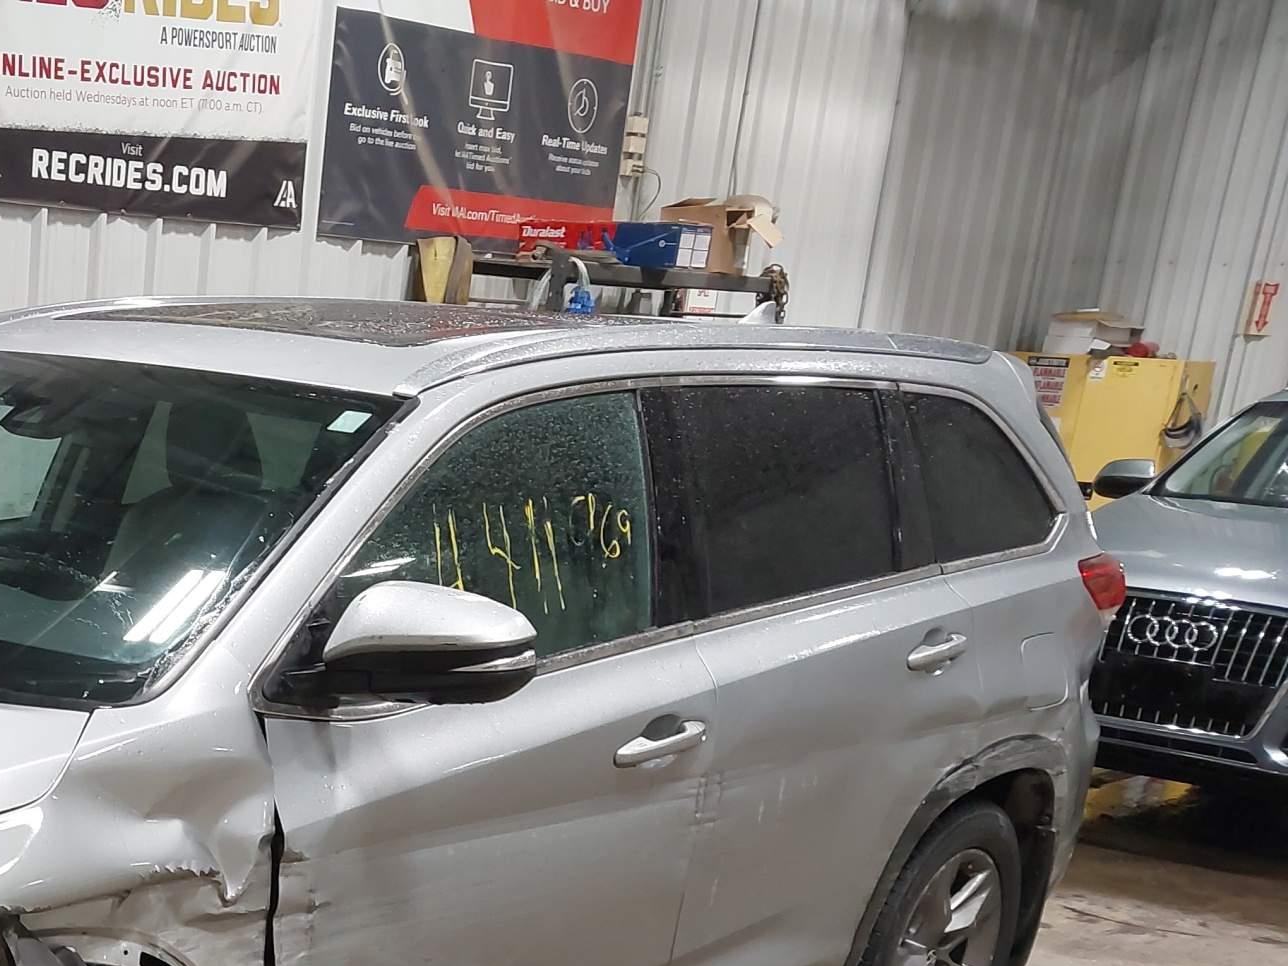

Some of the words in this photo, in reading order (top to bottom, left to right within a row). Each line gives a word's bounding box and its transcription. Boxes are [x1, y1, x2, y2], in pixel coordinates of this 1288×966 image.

[160, 26, 168, 45] A
[171, 27, 238, 50] POWERSPORT
[238, 33, 277, 54] AUCTION
[201, 69, 281, 95] AUCTION
[5, 85, 47, 100] Auction
[49, 88, 72, 101] held
[75, 89, 137, 107] Wednesdays
[139, 96, 149, 107] at
[152, 98, 178, 108] noon
[181, 97, 194, 109] ET
[343, 102, 389, 121] Exclusive
[411, 112, 430, 128] ook
[457, 121, 477, 136] Quick
[478, 128, 494, 138] and
[495, 129, 516, 143] Easy
[121, 142, 144, 157] Visit
[541, 134, 581, 151] Real-Time
[581, 140, 608, 155] Updates
[31, 147, 227, 198] RECRIDES.COM
[432, 202, 450, 217] Visit
[521, 225, 566, 238] Duralast
